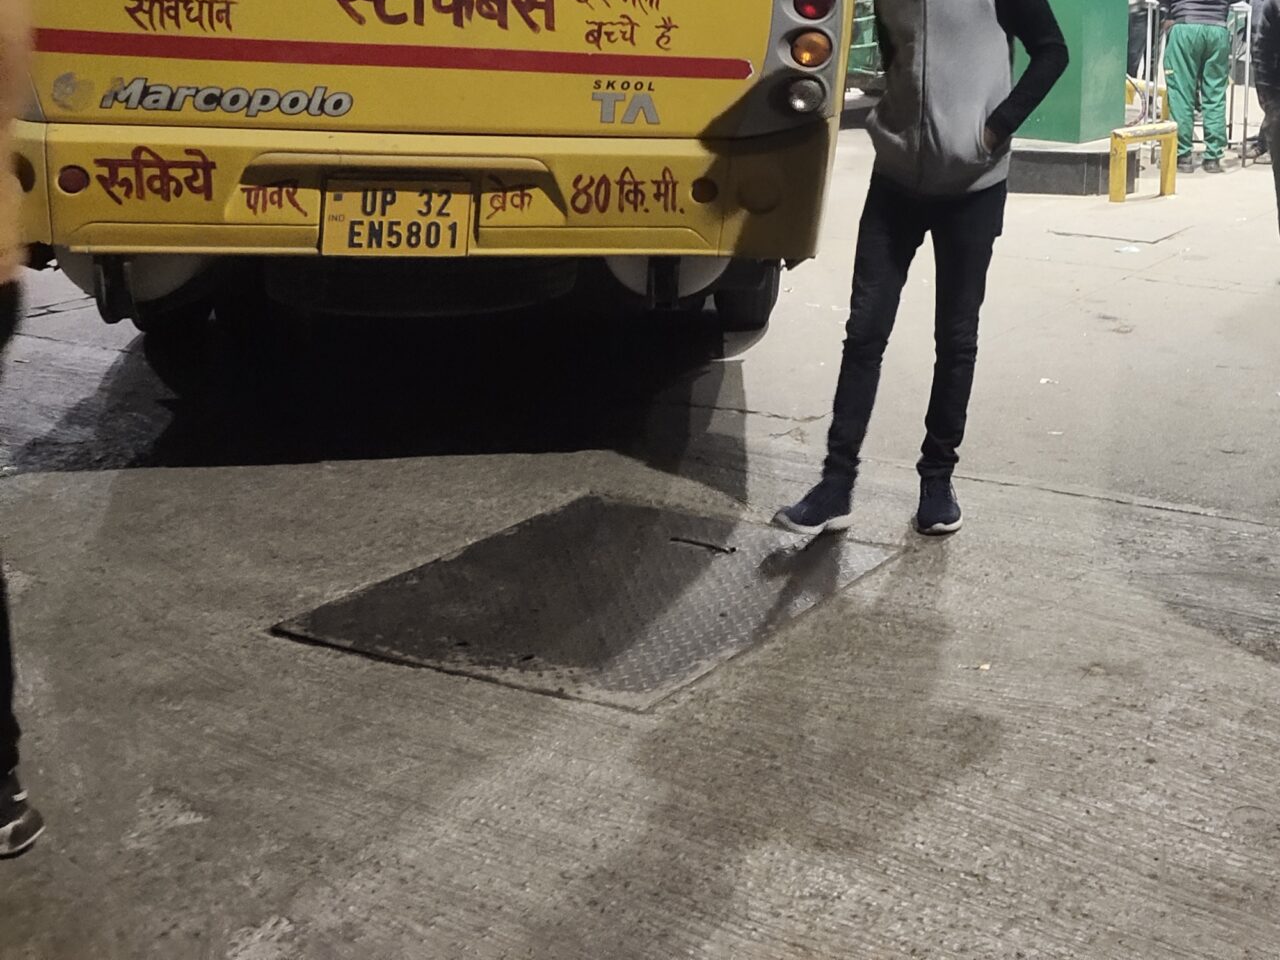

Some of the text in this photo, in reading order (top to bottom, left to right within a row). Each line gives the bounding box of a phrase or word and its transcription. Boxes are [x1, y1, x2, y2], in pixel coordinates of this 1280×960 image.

[585, 14, 679, 51] बच्चे है
[100, 76, 354, 118] Marcopolo
[593, 79, 656, 92] SKOOL
[360, 186, 453, 218] UP 32
[328, 214, 345, 222] IND
[348, 220, 458, 249] EN5801
